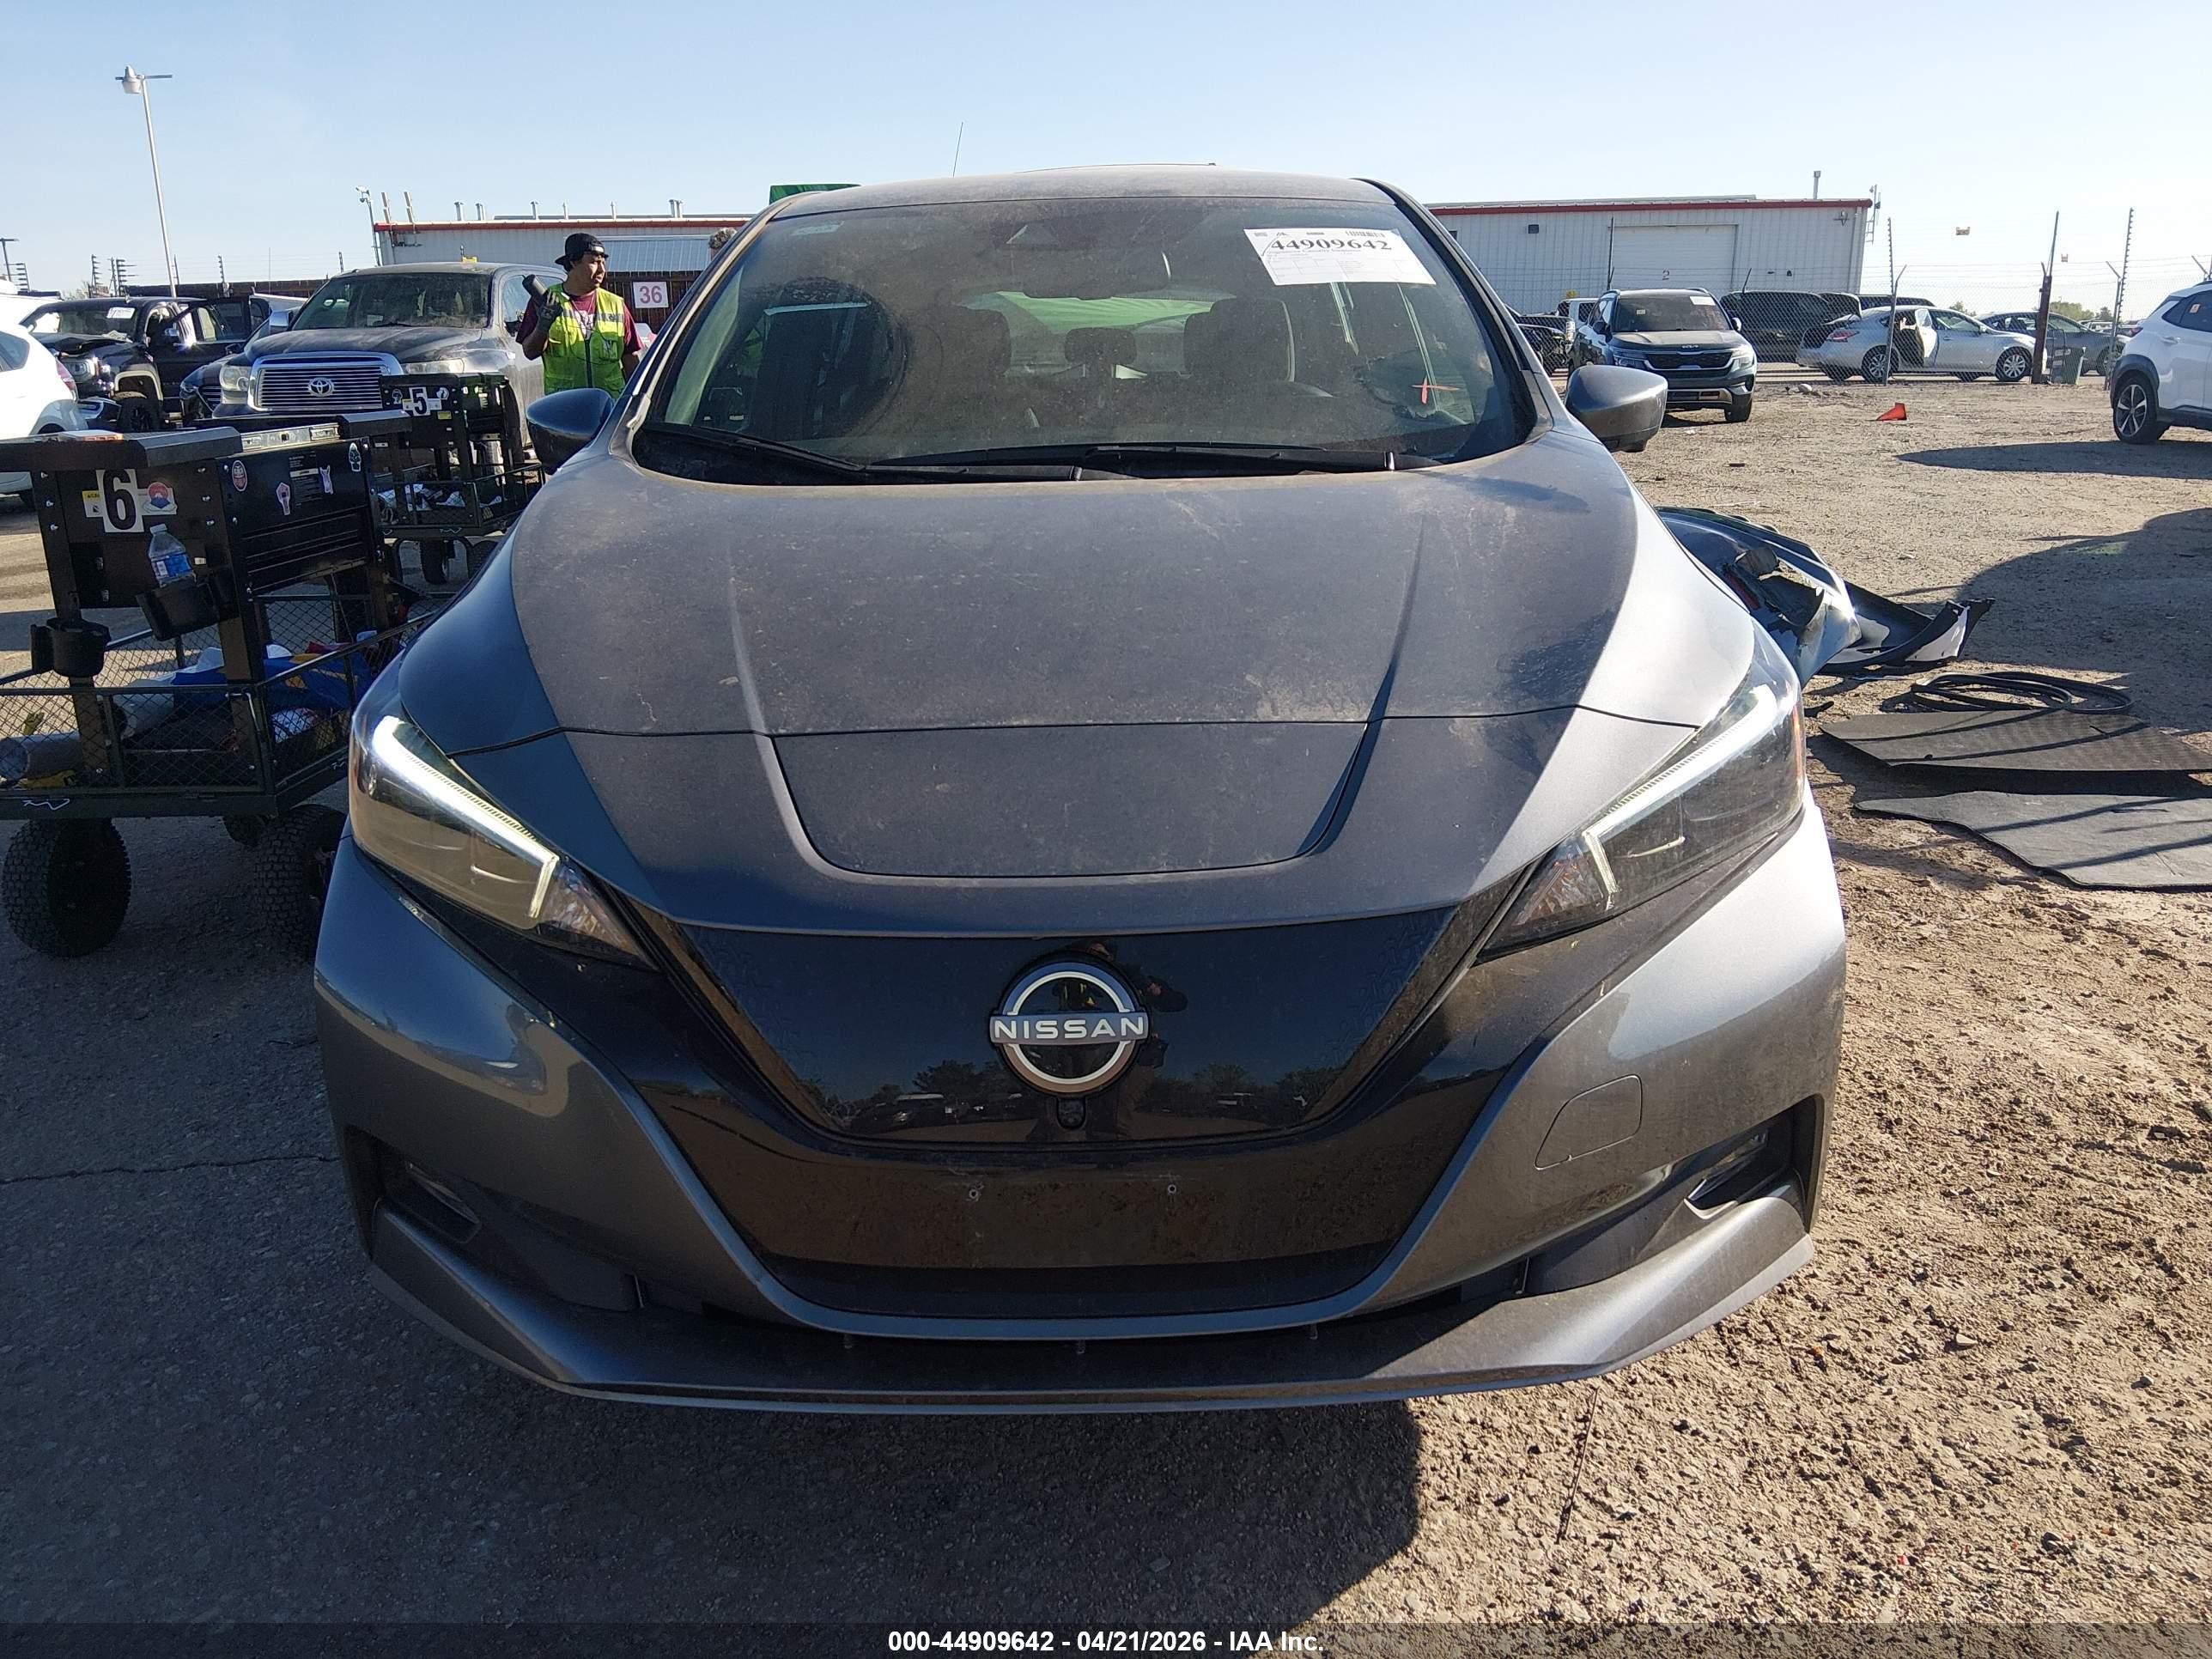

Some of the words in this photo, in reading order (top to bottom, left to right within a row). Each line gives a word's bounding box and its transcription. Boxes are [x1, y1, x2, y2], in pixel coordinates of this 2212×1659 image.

[1271, 239, 1392, 251] 44909642
[1662, 268, 1670, 281] 2
[639, 285, 663, 304] 36
[411, 388, 428, 415] 5
[103, 469, 137, 531] 6
[994, 1016, 1144, 1040] NISSAN
